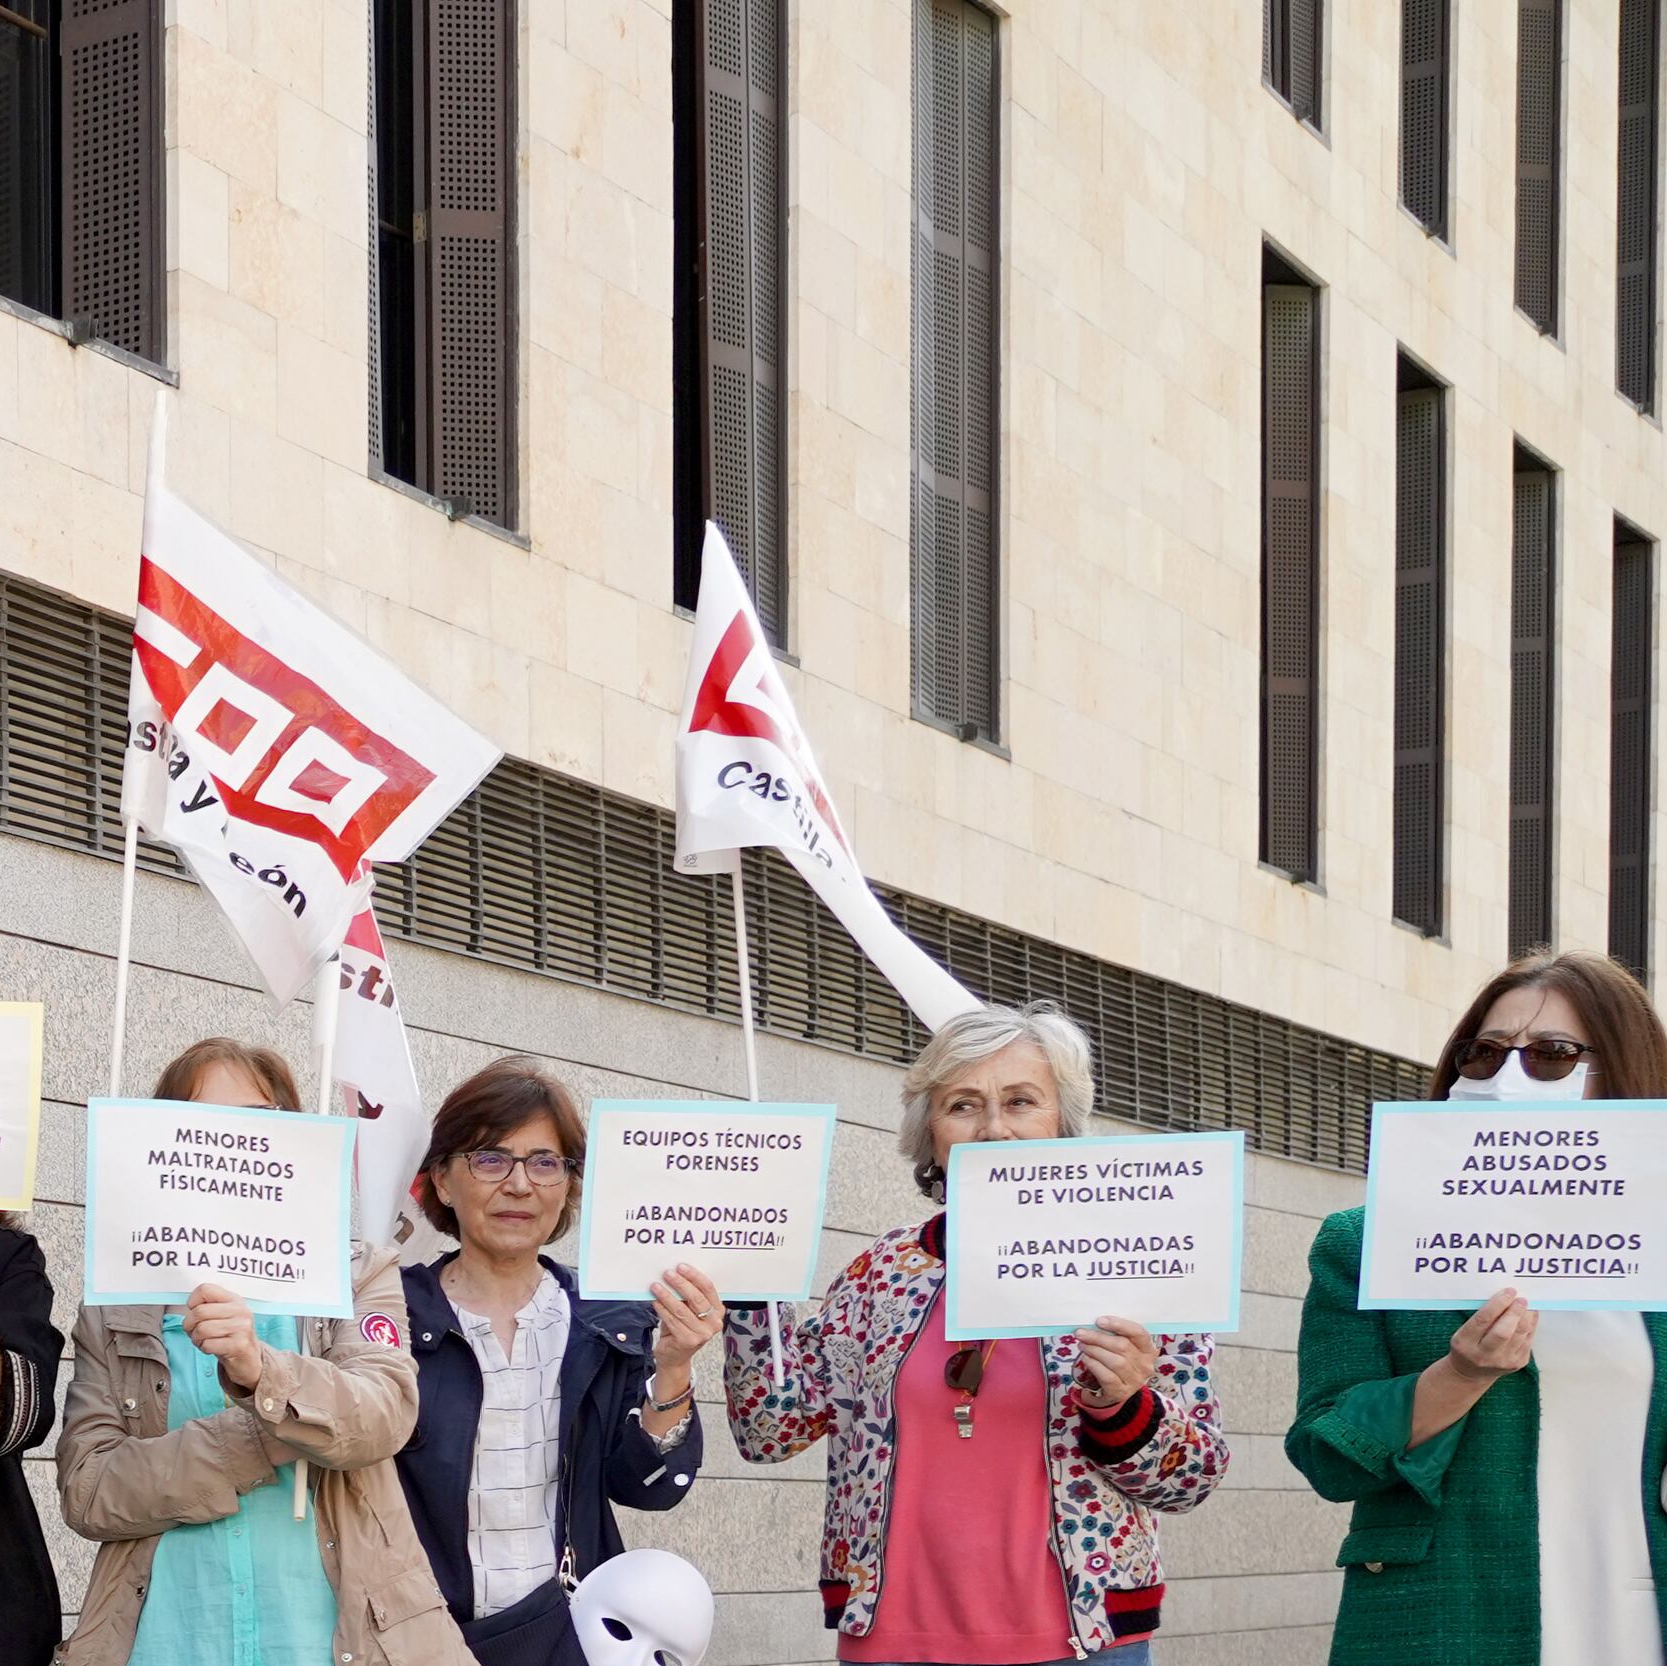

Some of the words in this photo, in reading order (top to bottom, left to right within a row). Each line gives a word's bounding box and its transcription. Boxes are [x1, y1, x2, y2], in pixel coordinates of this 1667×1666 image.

[176, 1128, 269, 1153] MENORES
[623, 1130, 708, 1147] EQUIPOS
[715, 1128, 802, 1150] TÉCNICOS
[1473, 1130, 1599, 1147] MENORES
[148, 1150, 293, 1179] MALTRATADOS
[667, 1155, 759, 1172] FORENSES
[989, 1165, 1088, 1182] MUJERES
[1096, 1158, 1203, 1178] VÍCTIMAS
[1462, 1155, 1607, 1171] ABUSADOS
[160, 1169, 283, 1202] FÍSICAMENTE
[1442, 1179, 1625, 1196] SEXUALMENTE
[1018, 1189, 1043, 1205] DE
[1052, 1185, 1174, 1203] VIOLENCIA
[624, 1228, 665, 1244] POR
[673, 1229, 695, 1244] LA
[132, 1250, 178, 1267] POR
[187, 1251, 211, 1267] LA
[1415, 1257, 1468, 1273] POR
[1478, 1257, 1507, 1273] LA
[998, 1263, 1044, 1279] POR
[1053, 1262, 1079, 1277] LA
